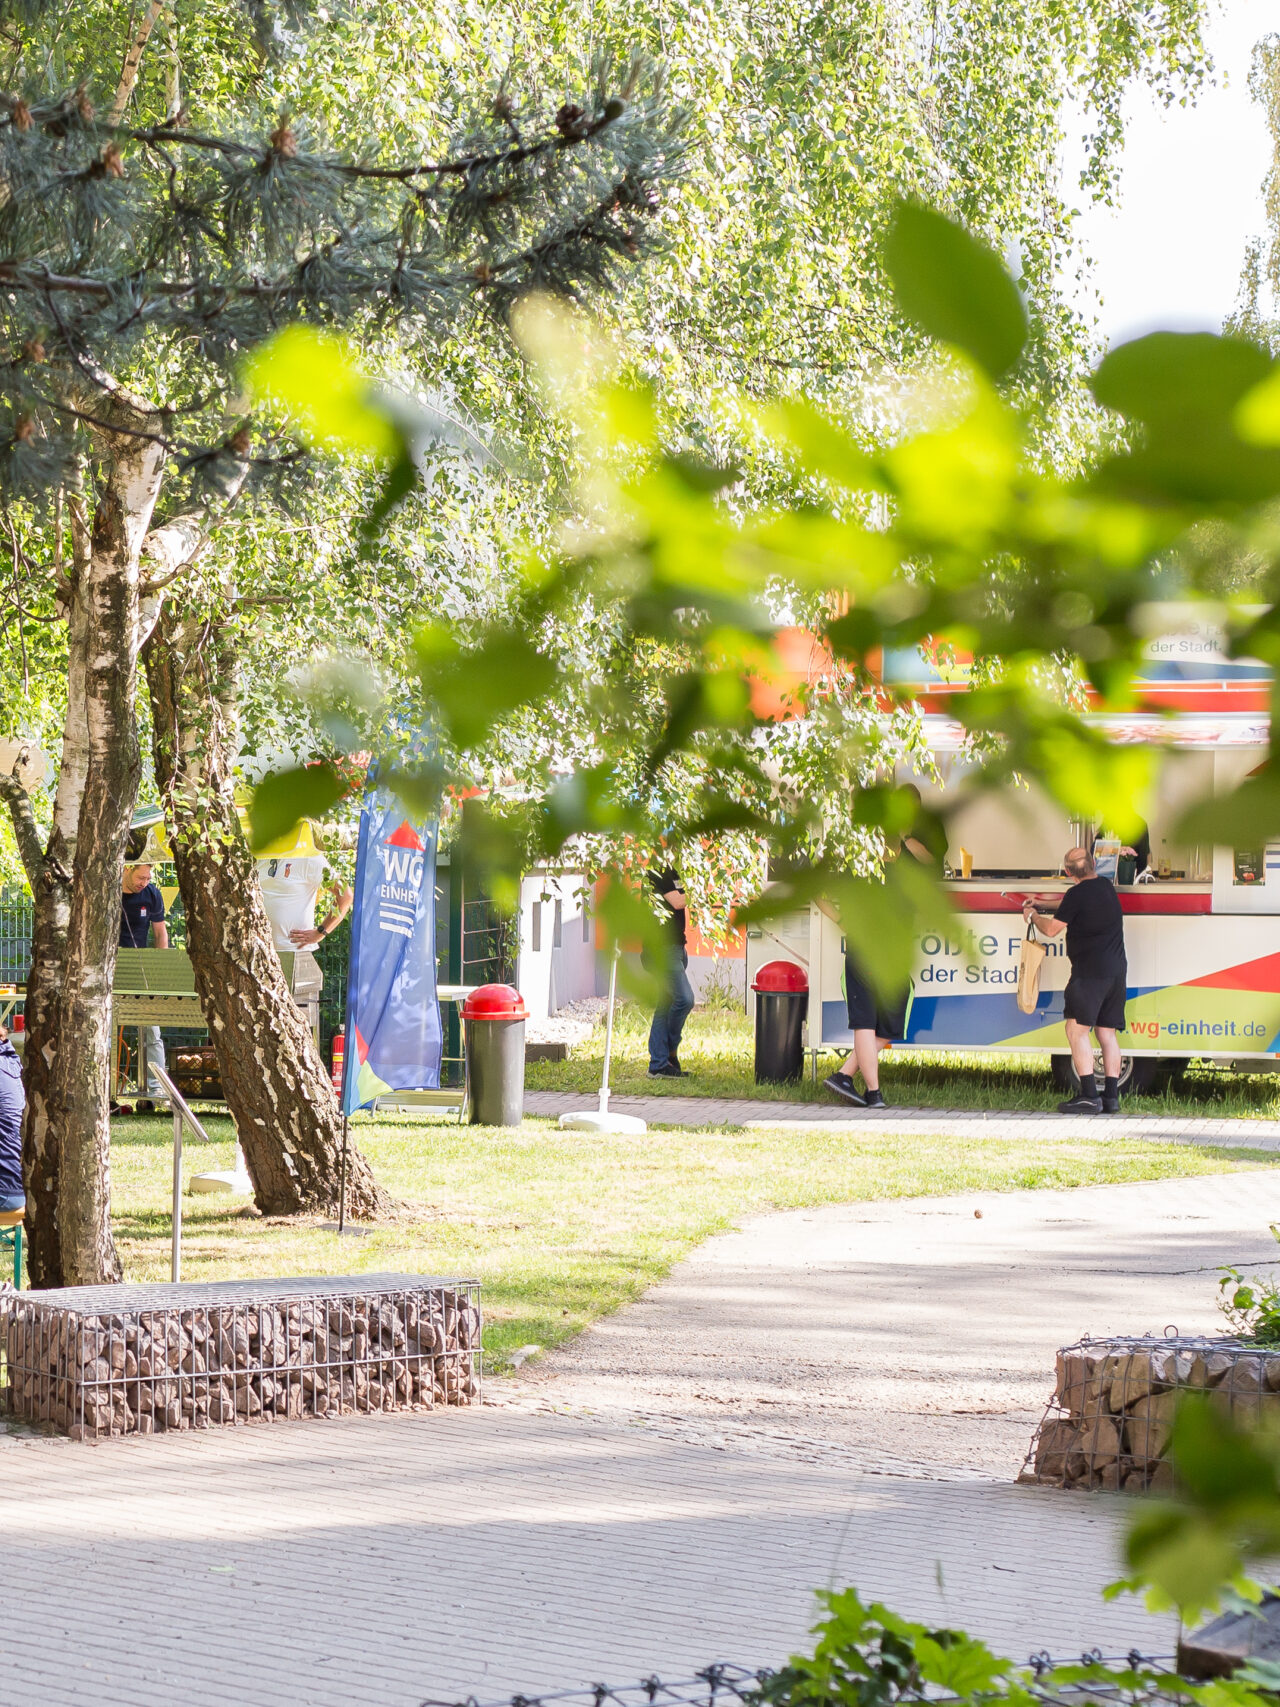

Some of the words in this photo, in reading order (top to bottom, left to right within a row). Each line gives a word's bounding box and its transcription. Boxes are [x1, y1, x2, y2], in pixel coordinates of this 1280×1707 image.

[1150, 641, 1176, 653] der
[383, 848, 425, 888] WG
[920, 964, 958, 982] der
[965, 965, 1018, 984] Stad
